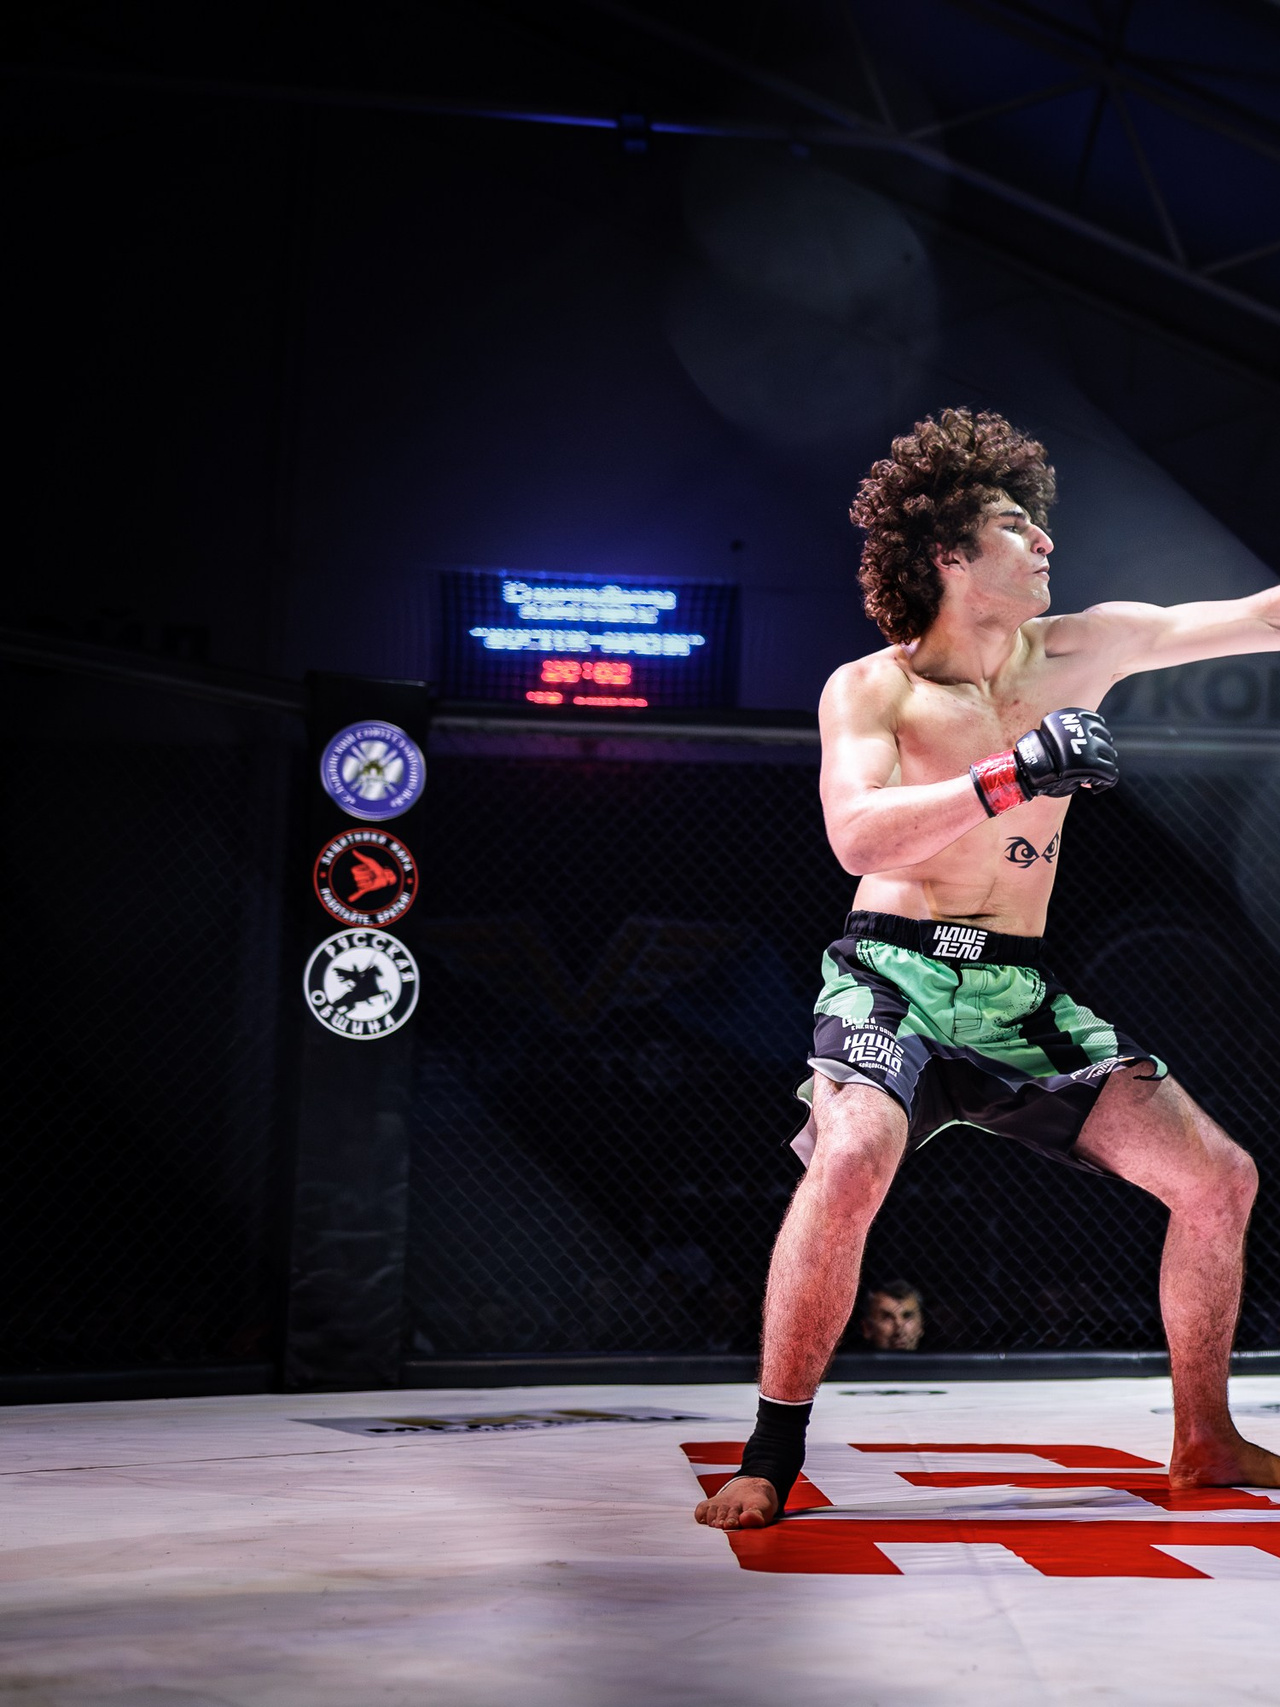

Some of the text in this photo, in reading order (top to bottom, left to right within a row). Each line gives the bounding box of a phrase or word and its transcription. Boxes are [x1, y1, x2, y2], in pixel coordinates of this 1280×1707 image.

[1059, 713, 1088, 755] NFL
[324, 932, 415, 983] РУССКАЯ
[932, 941, 983, 960] ДЕЛО
[310, 990, 397, 1035] ОБЩИНА
